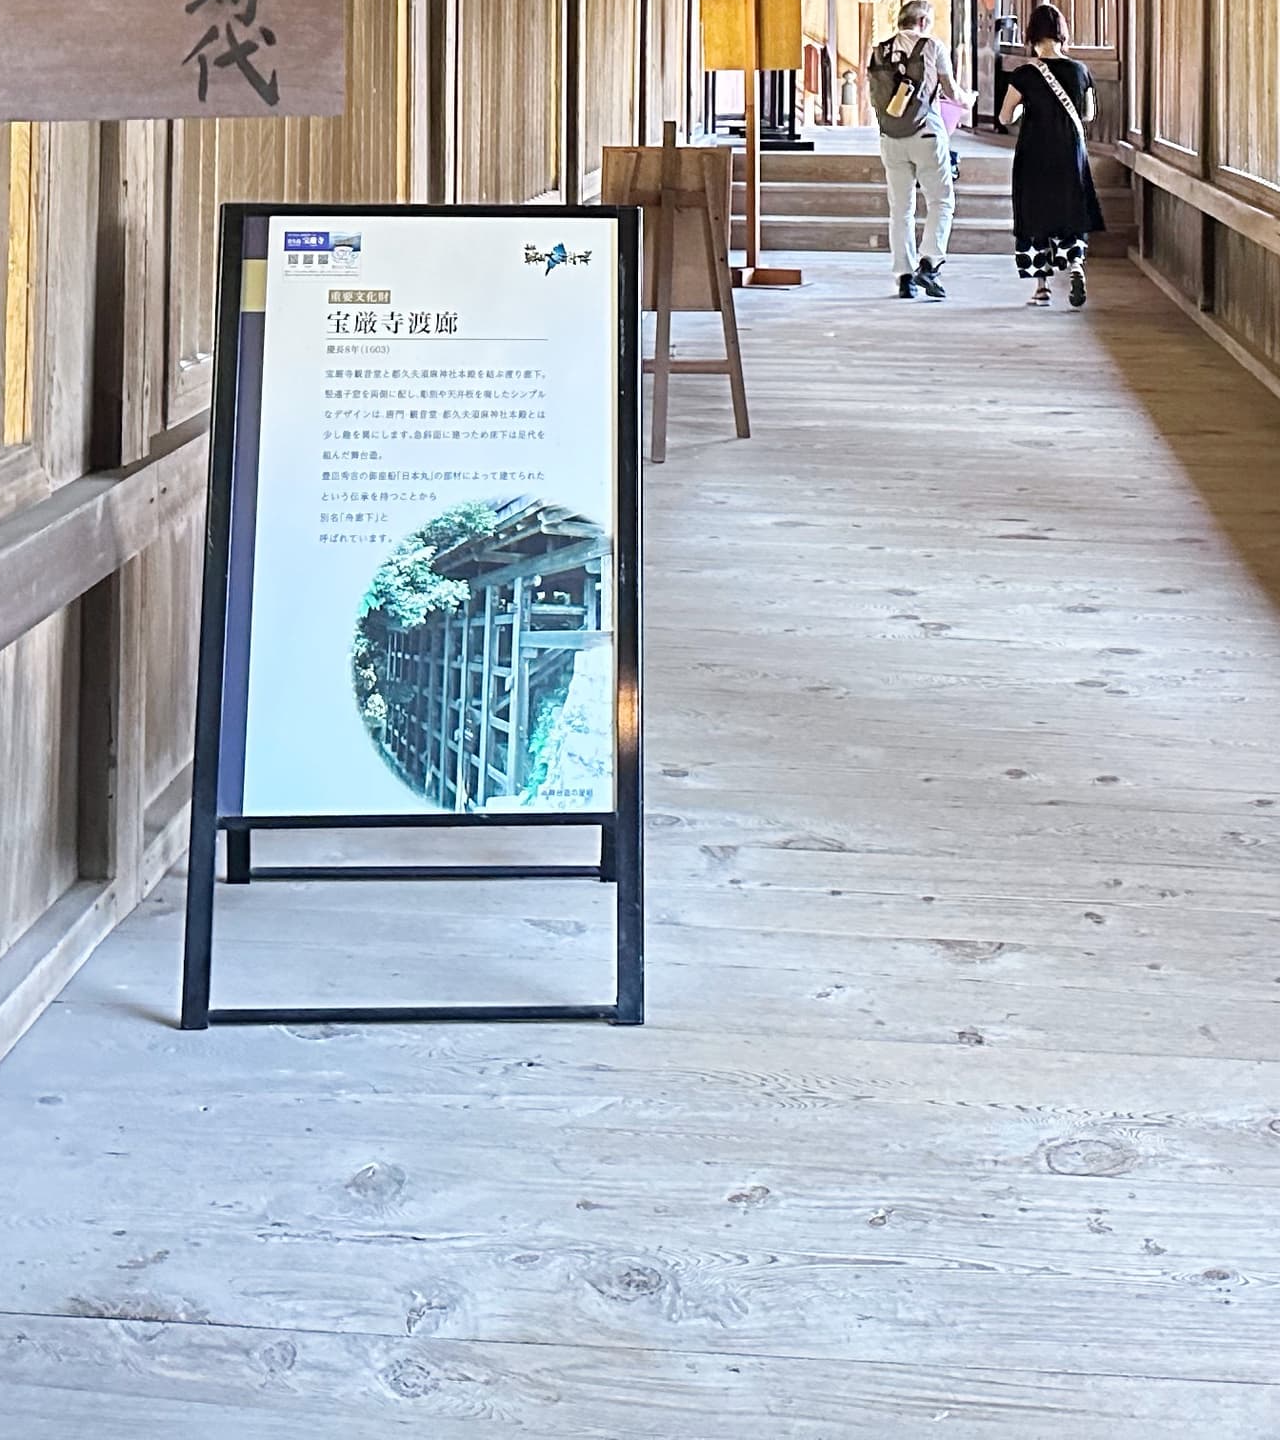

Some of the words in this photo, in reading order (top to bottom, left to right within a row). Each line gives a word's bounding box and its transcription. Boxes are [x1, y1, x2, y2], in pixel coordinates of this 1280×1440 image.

[329, 290, 390, 304] 重要文化財
[326, 311, 459, 335] 宝厳寺渡廊
[321, 491, 437, 502] という伝承を持つことから
[320, 512, 389, 523] 別名「舟廊下」と
[319, 533, 393, 544] 呼ばれています。
